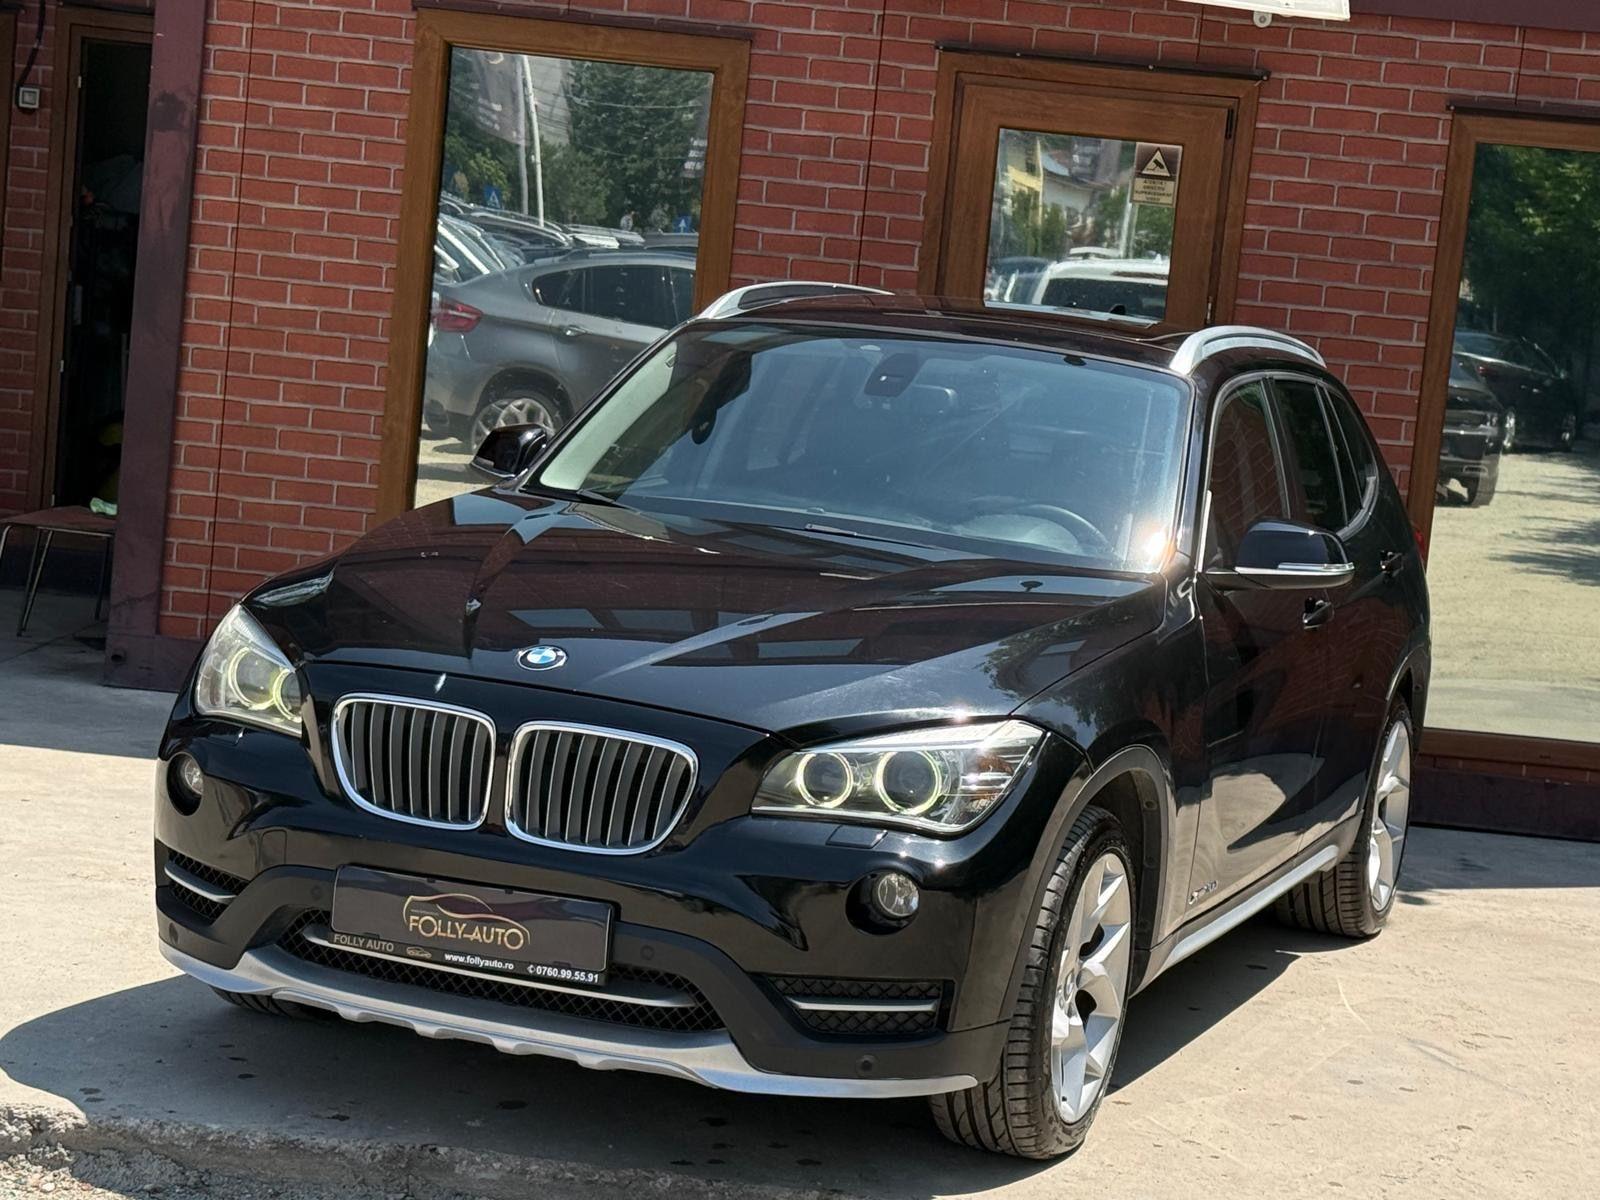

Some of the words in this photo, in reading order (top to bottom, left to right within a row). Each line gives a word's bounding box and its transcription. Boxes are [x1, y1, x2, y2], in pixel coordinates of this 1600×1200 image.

[334, 934, 365, 948] FOLLY
[366, 939, 395, 952] AUTO
[444, 953, 514, 970] www.follyauto.ro
[536, 965, 599, 983] 0760.99.55.91
